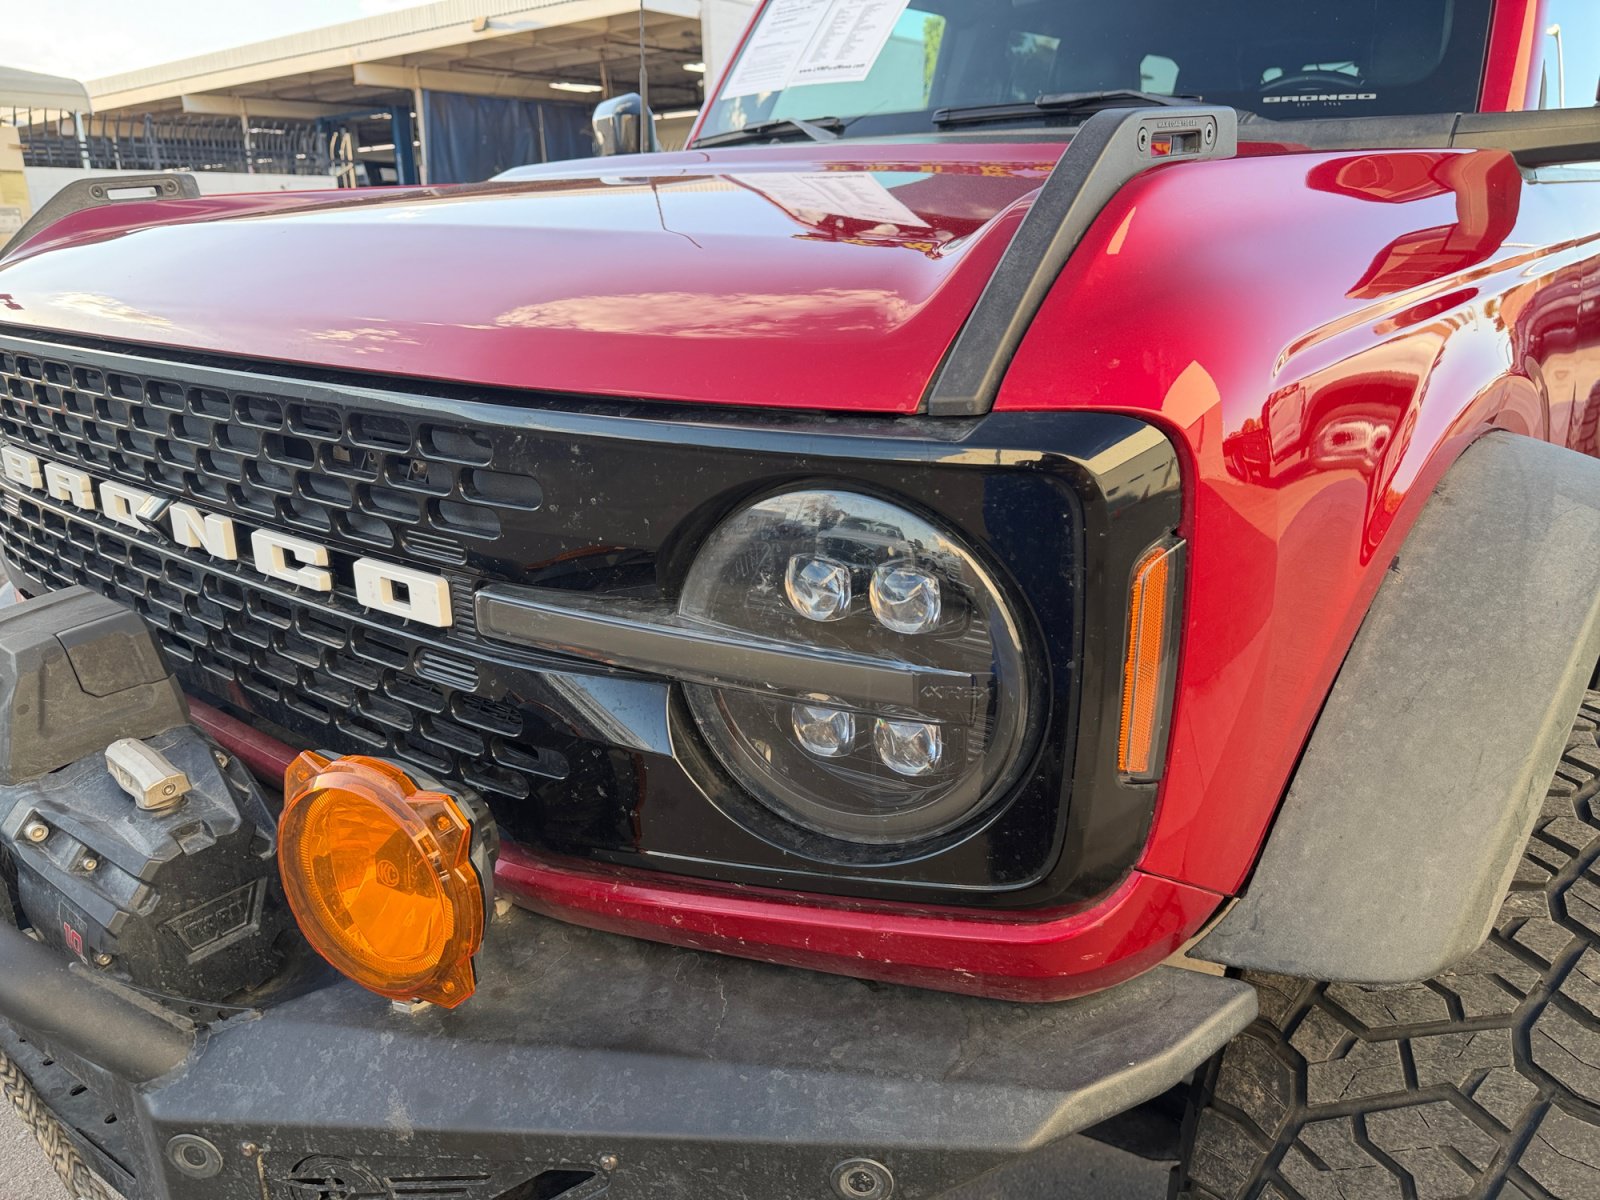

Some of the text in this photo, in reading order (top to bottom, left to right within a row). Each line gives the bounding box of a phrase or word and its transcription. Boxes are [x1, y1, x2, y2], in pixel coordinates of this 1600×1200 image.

[1263, 93, 1376, 103] BRONCO
[1, 444, 453, 628] BRONCO
[377, 861, 399, 886] KC
[63, 921, 83, 956] 10
